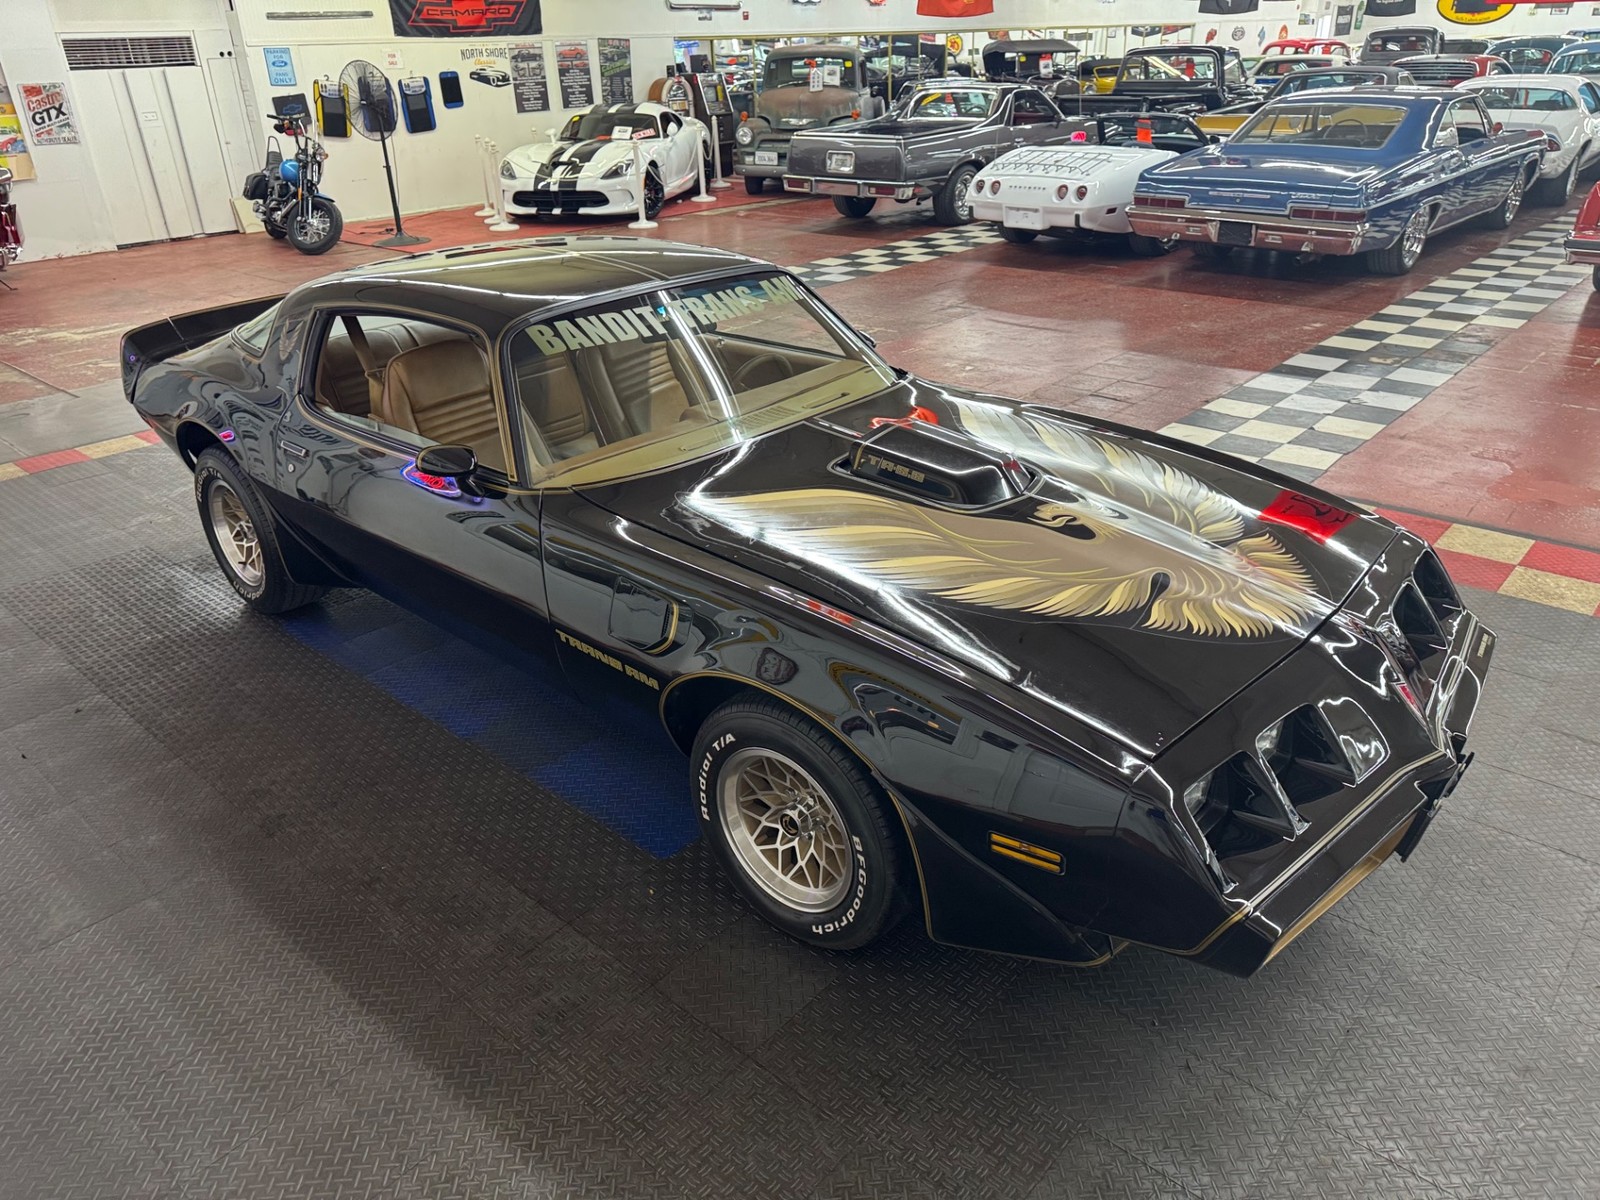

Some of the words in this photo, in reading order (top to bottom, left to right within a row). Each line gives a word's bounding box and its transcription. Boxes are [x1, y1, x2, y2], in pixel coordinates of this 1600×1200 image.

[426, 7, 510, 17] CAMARO
[460, 48, 484, 61] NORTH
[485, 47, 508, 60] SHORE
[31, 101, 68, 126] GTX
[525, 306, 668, 356] BANDIT
[670, 286, 765, 328] TRANS
[759, 276, 804, 305] AM
[555, 628, 623, 672] TRANS
[624, 664, 660, 691] AM
[698, 752, 714, 821] Radial
[712, 733, 736, 751] T/A
[811, 834, 867, 935] BFGoodrich
